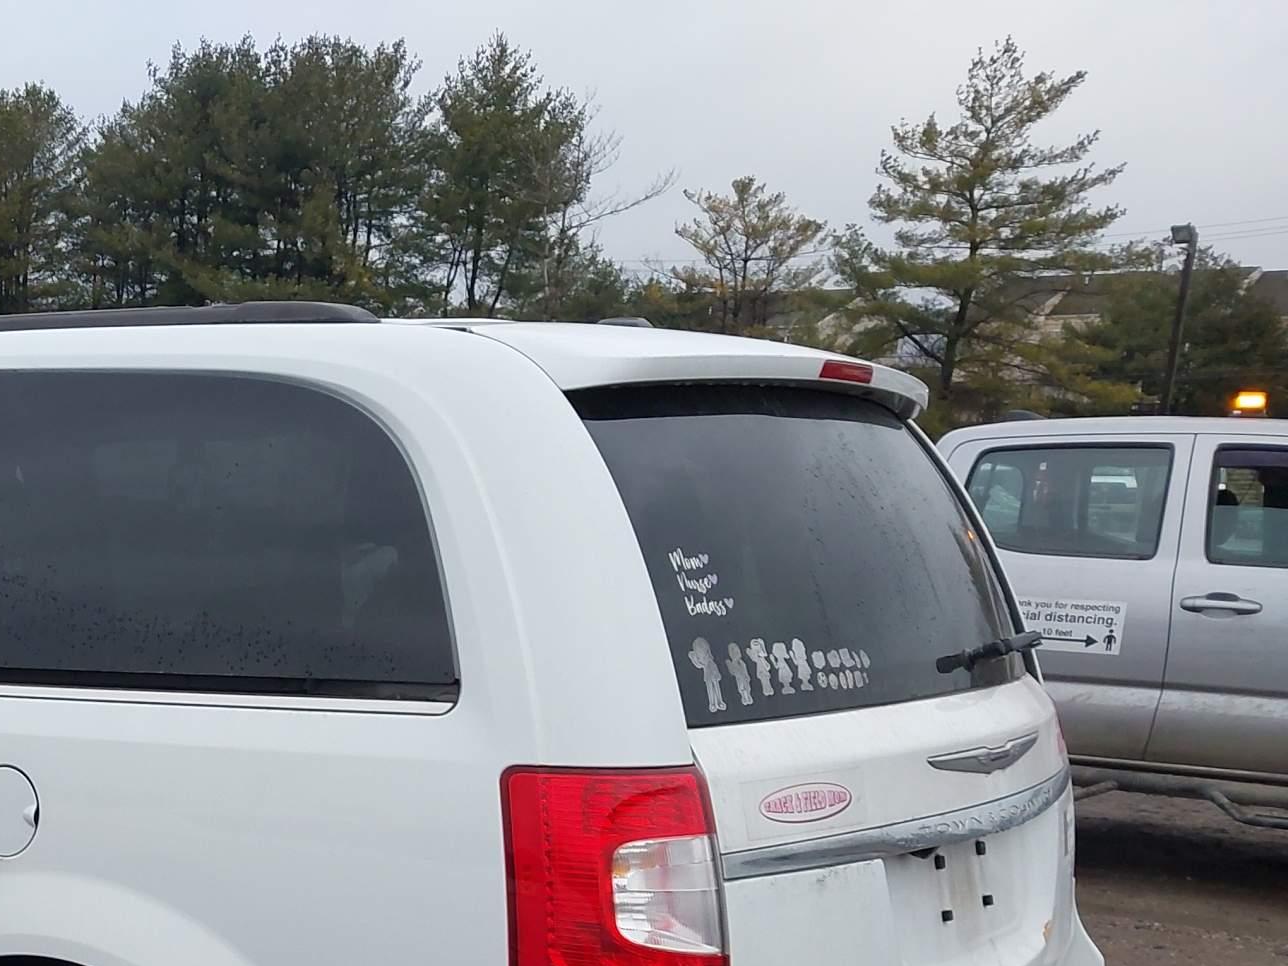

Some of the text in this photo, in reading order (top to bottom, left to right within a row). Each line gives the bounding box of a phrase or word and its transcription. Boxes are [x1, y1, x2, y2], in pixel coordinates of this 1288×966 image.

[668, 547, 703, 572] Mom
[676, 571, 712, 594] Nurse
[684, 594, 727, 616] Badass
[1035, 601, 1052, 609] you
[1055, 600, 1068, 609] for
[1070, 602, 1121, 614] respecting
[1044, 611, 1118, 628] distancing.
[1042, 627, 1073, 637] 10 feet
